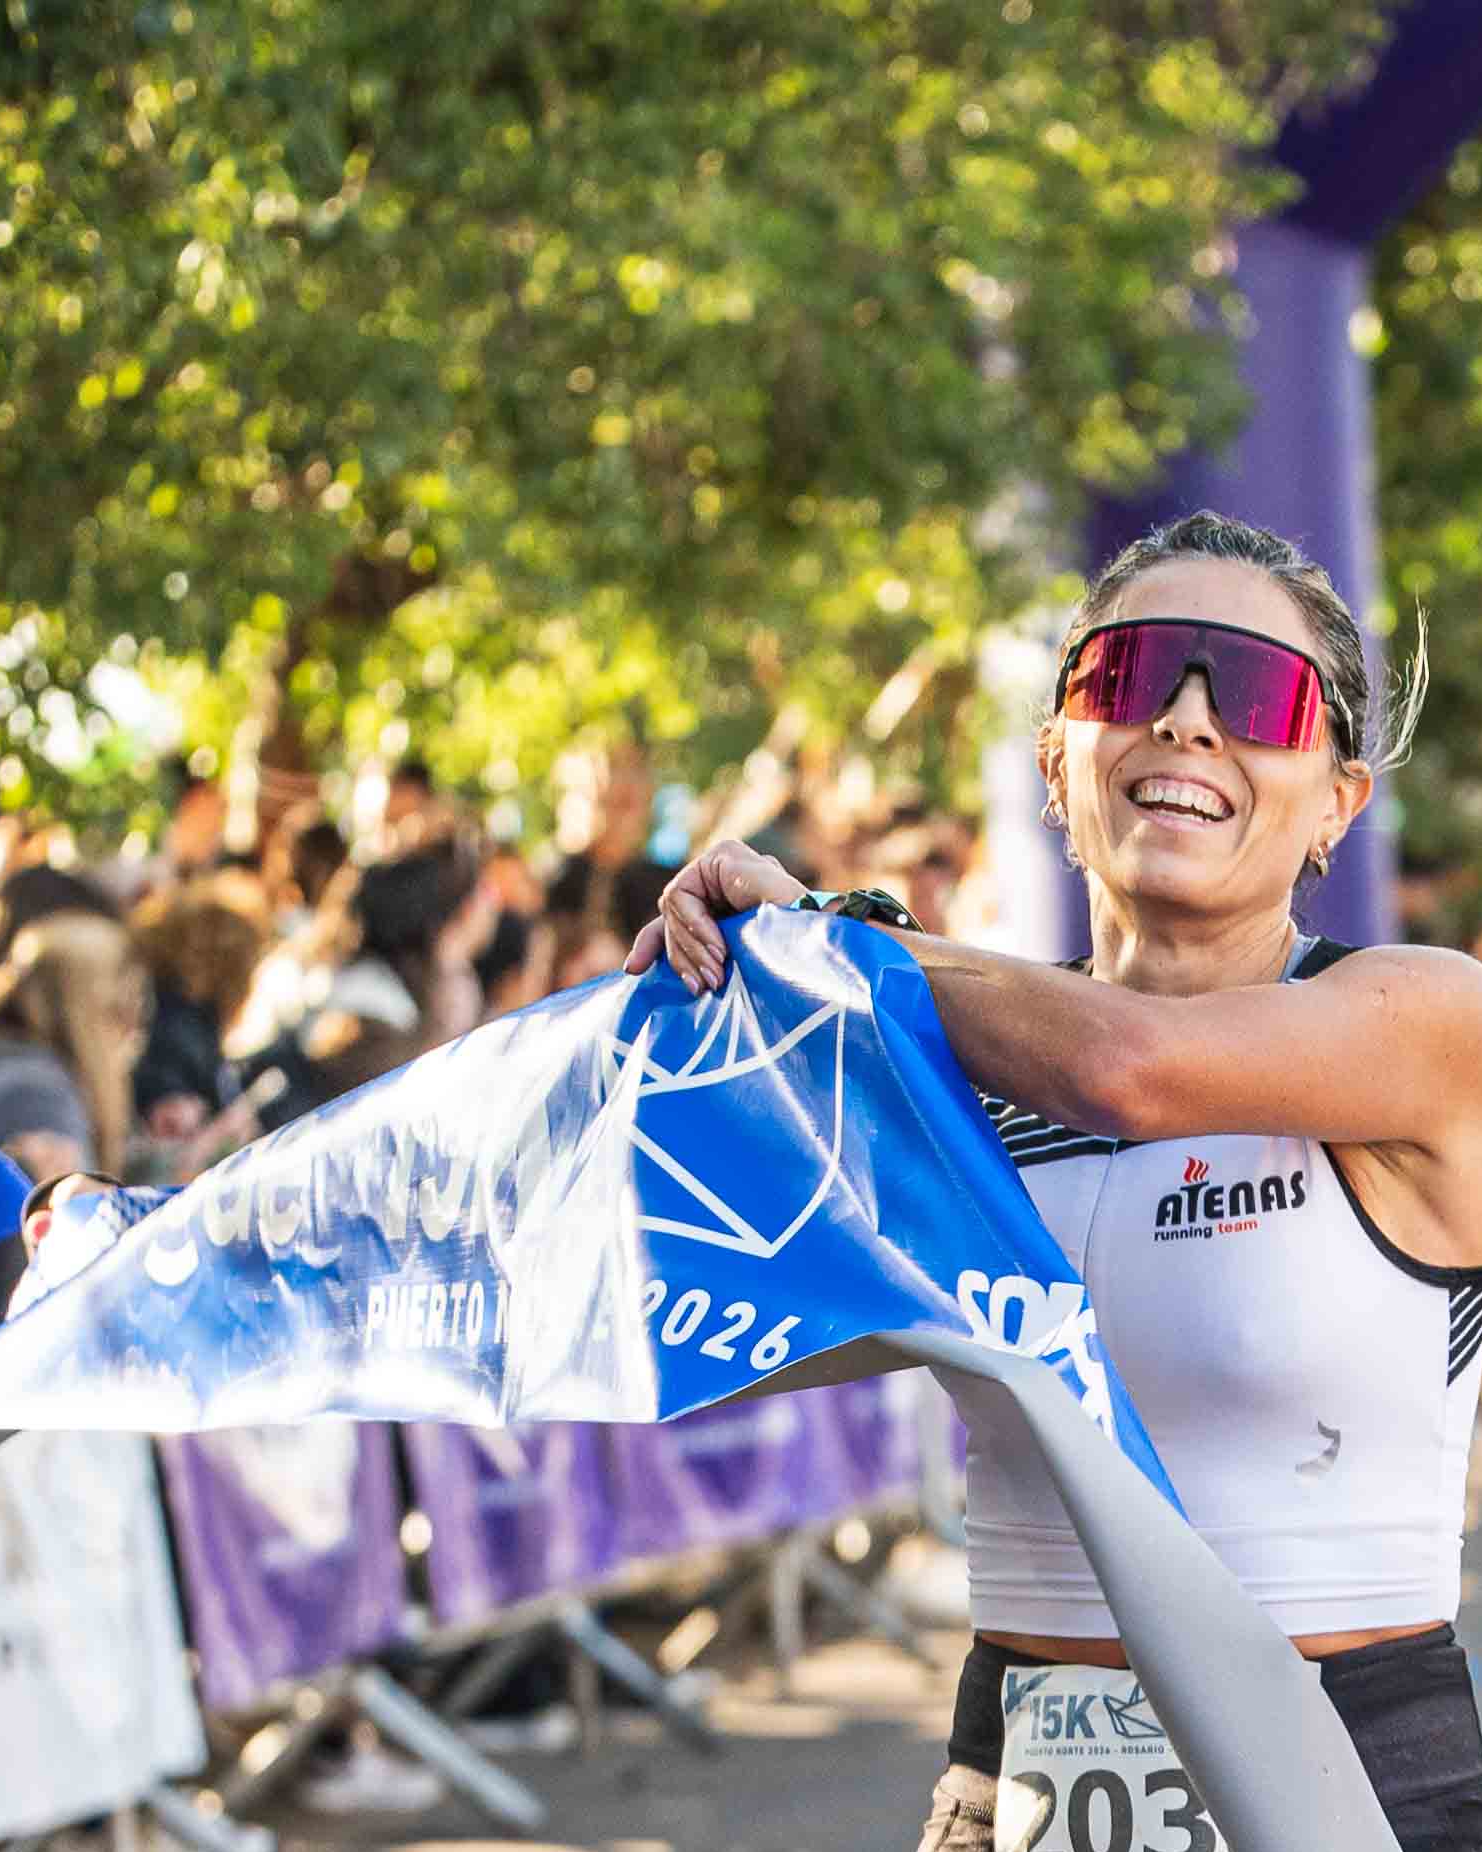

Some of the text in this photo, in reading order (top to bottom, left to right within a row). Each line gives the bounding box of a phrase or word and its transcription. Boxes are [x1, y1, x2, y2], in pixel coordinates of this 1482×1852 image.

[1155, 1170, 1306, 1227] ATENAS
[1154, 1219, 1258, 1242] running team
[364, 1279, 485, 1349] PUERTO
[1029, 1694, 1097, 1741] 15K
[1121, 1745, 1165, 1755] ROSARIO
